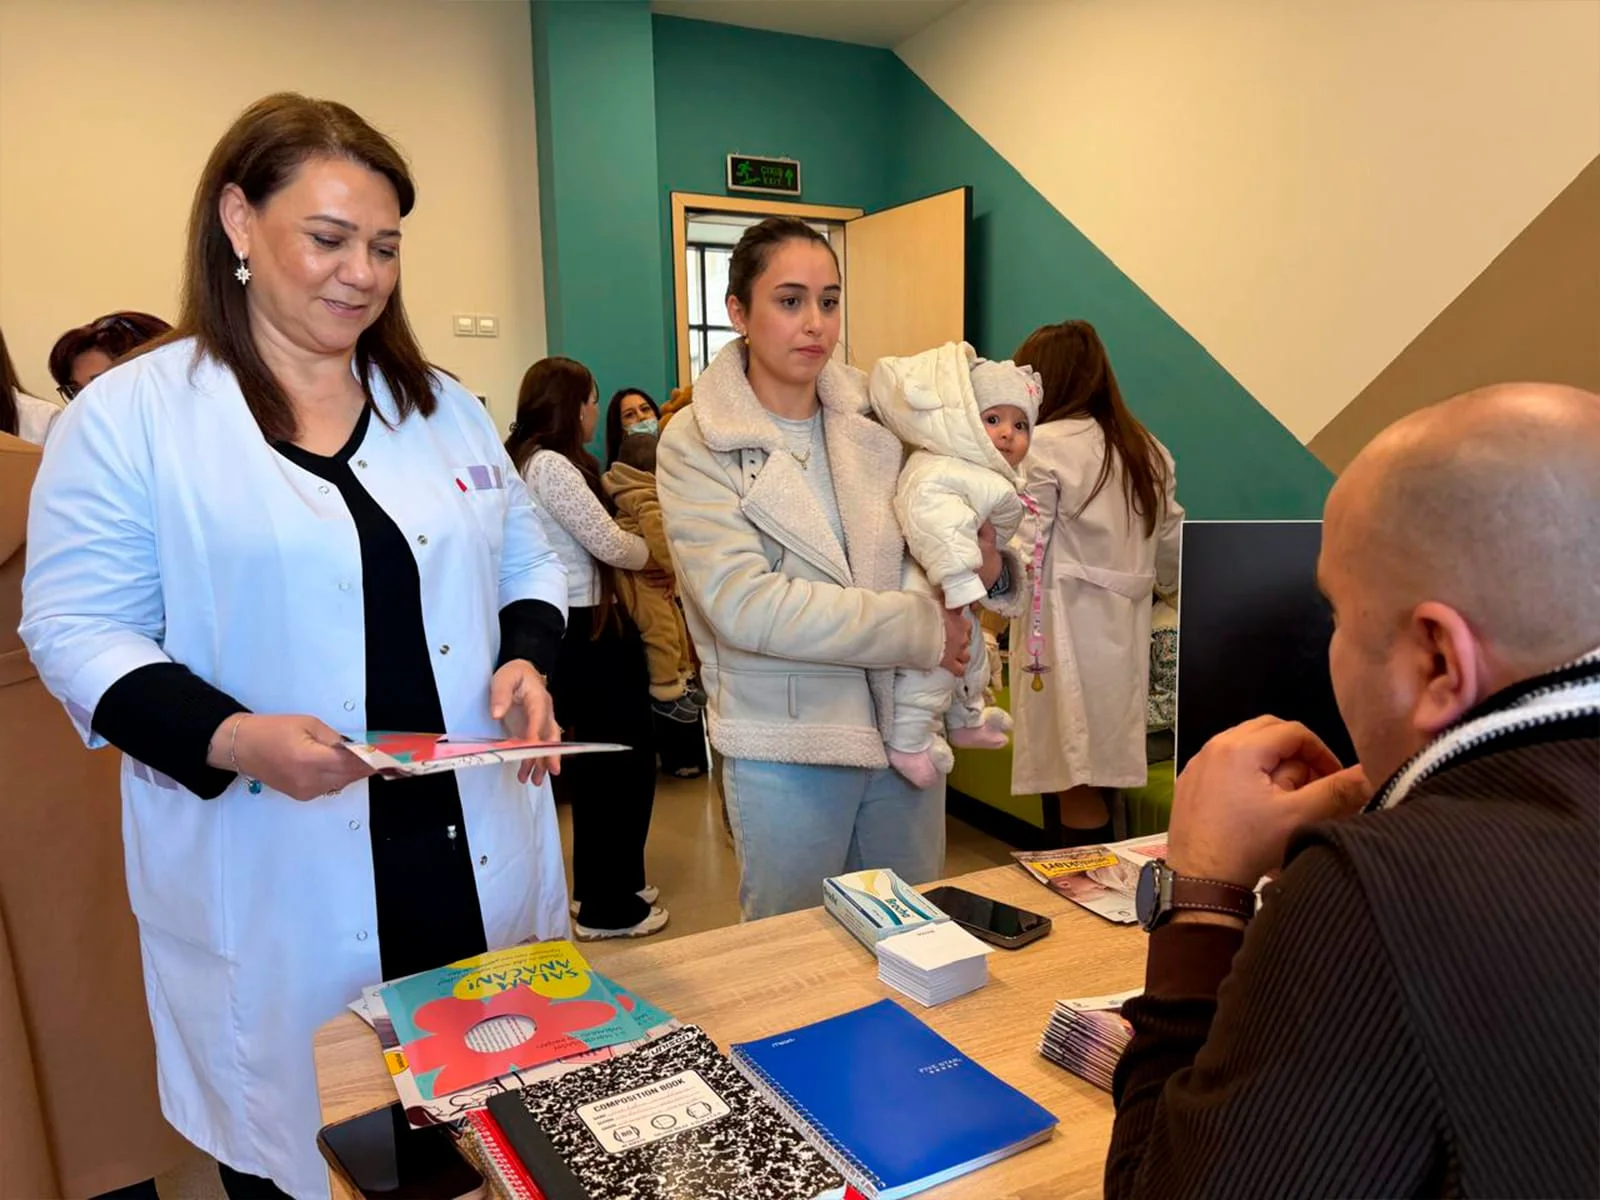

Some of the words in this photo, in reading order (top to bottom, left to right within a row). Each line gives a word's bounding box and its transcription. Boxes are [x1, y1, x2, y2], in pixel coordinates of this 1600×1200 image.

[467, 959, 570, 990] ANACAN!
[497, 968, 579, 992] SALAM
[651, 1034, 690, 1055] unison
[593, 1086, 659, 1112] COMPOSITION
[659, 1078, 685, 1094] BOOK
